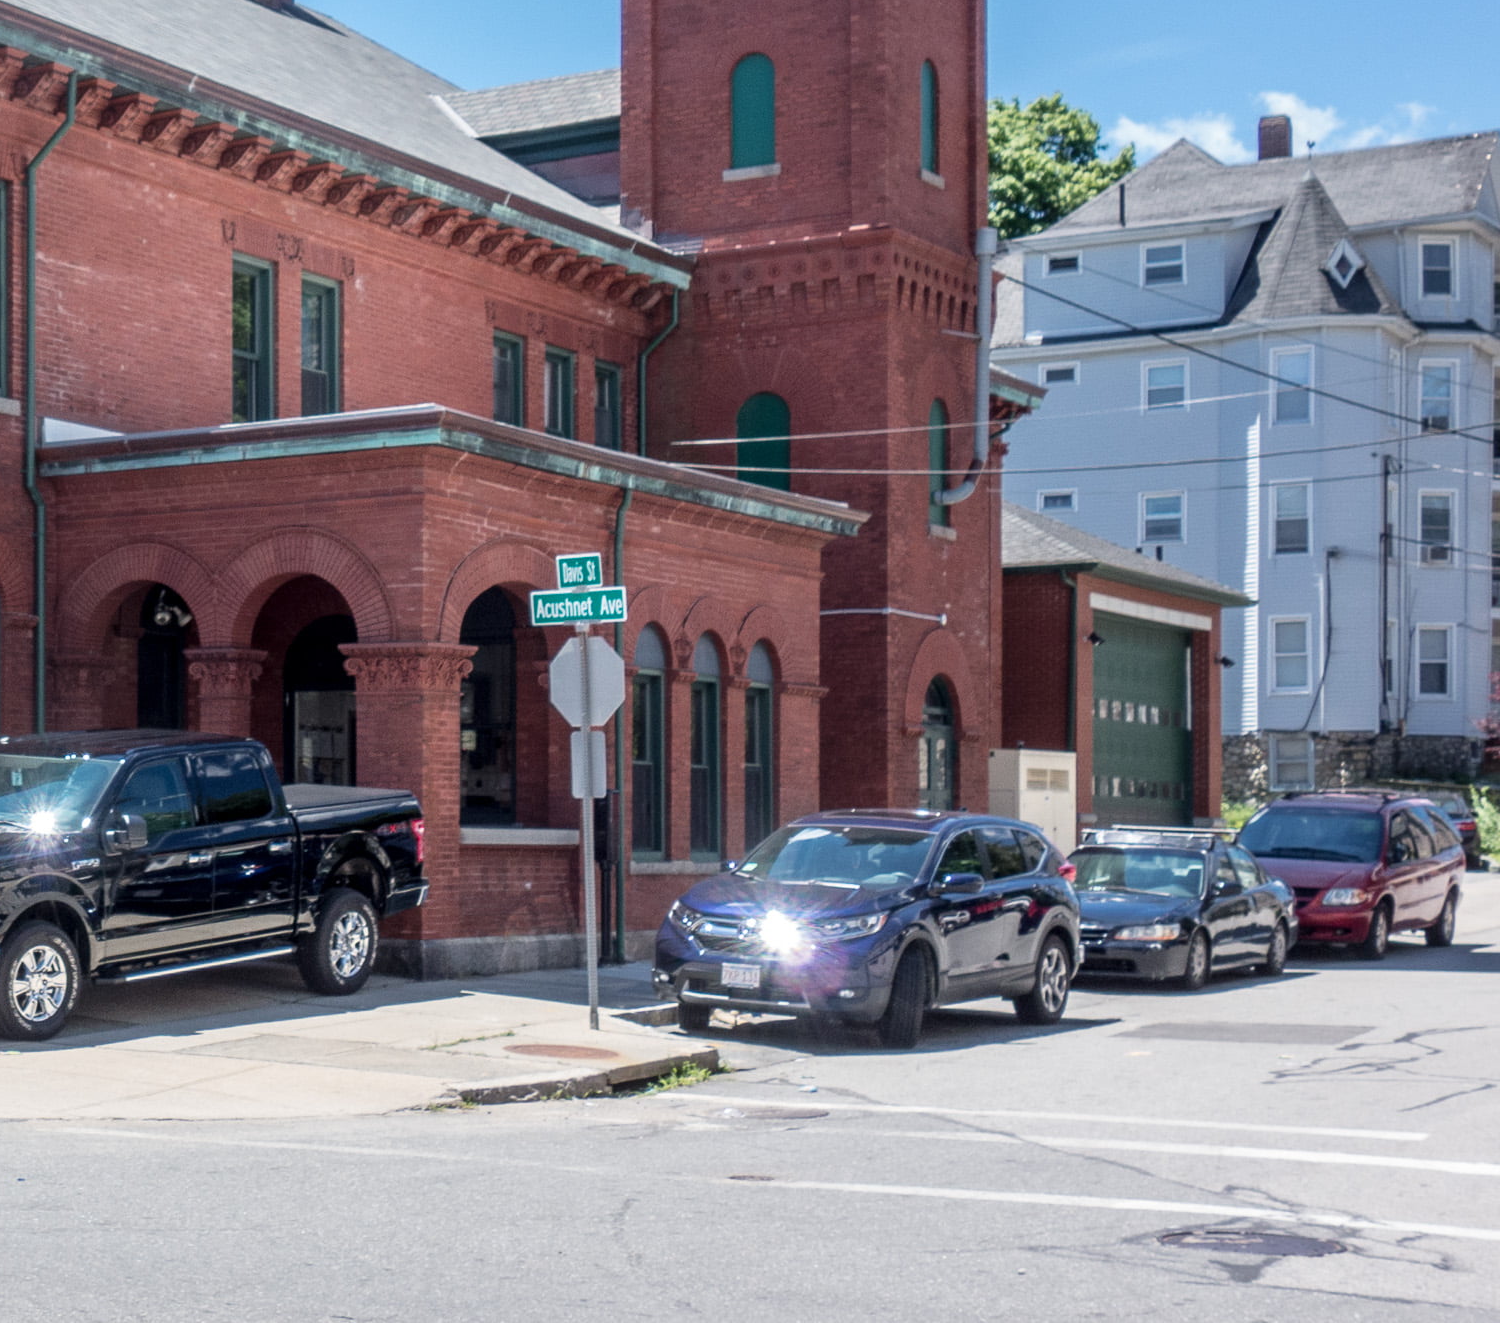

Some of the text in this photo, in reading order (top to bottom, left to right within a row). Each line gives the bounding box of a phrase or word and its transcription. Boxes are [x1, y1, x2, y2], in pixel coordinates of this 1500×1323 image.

[562, 561, 596, 583] Davis St
[536, 595, 624, 618] Acushnet Ave
